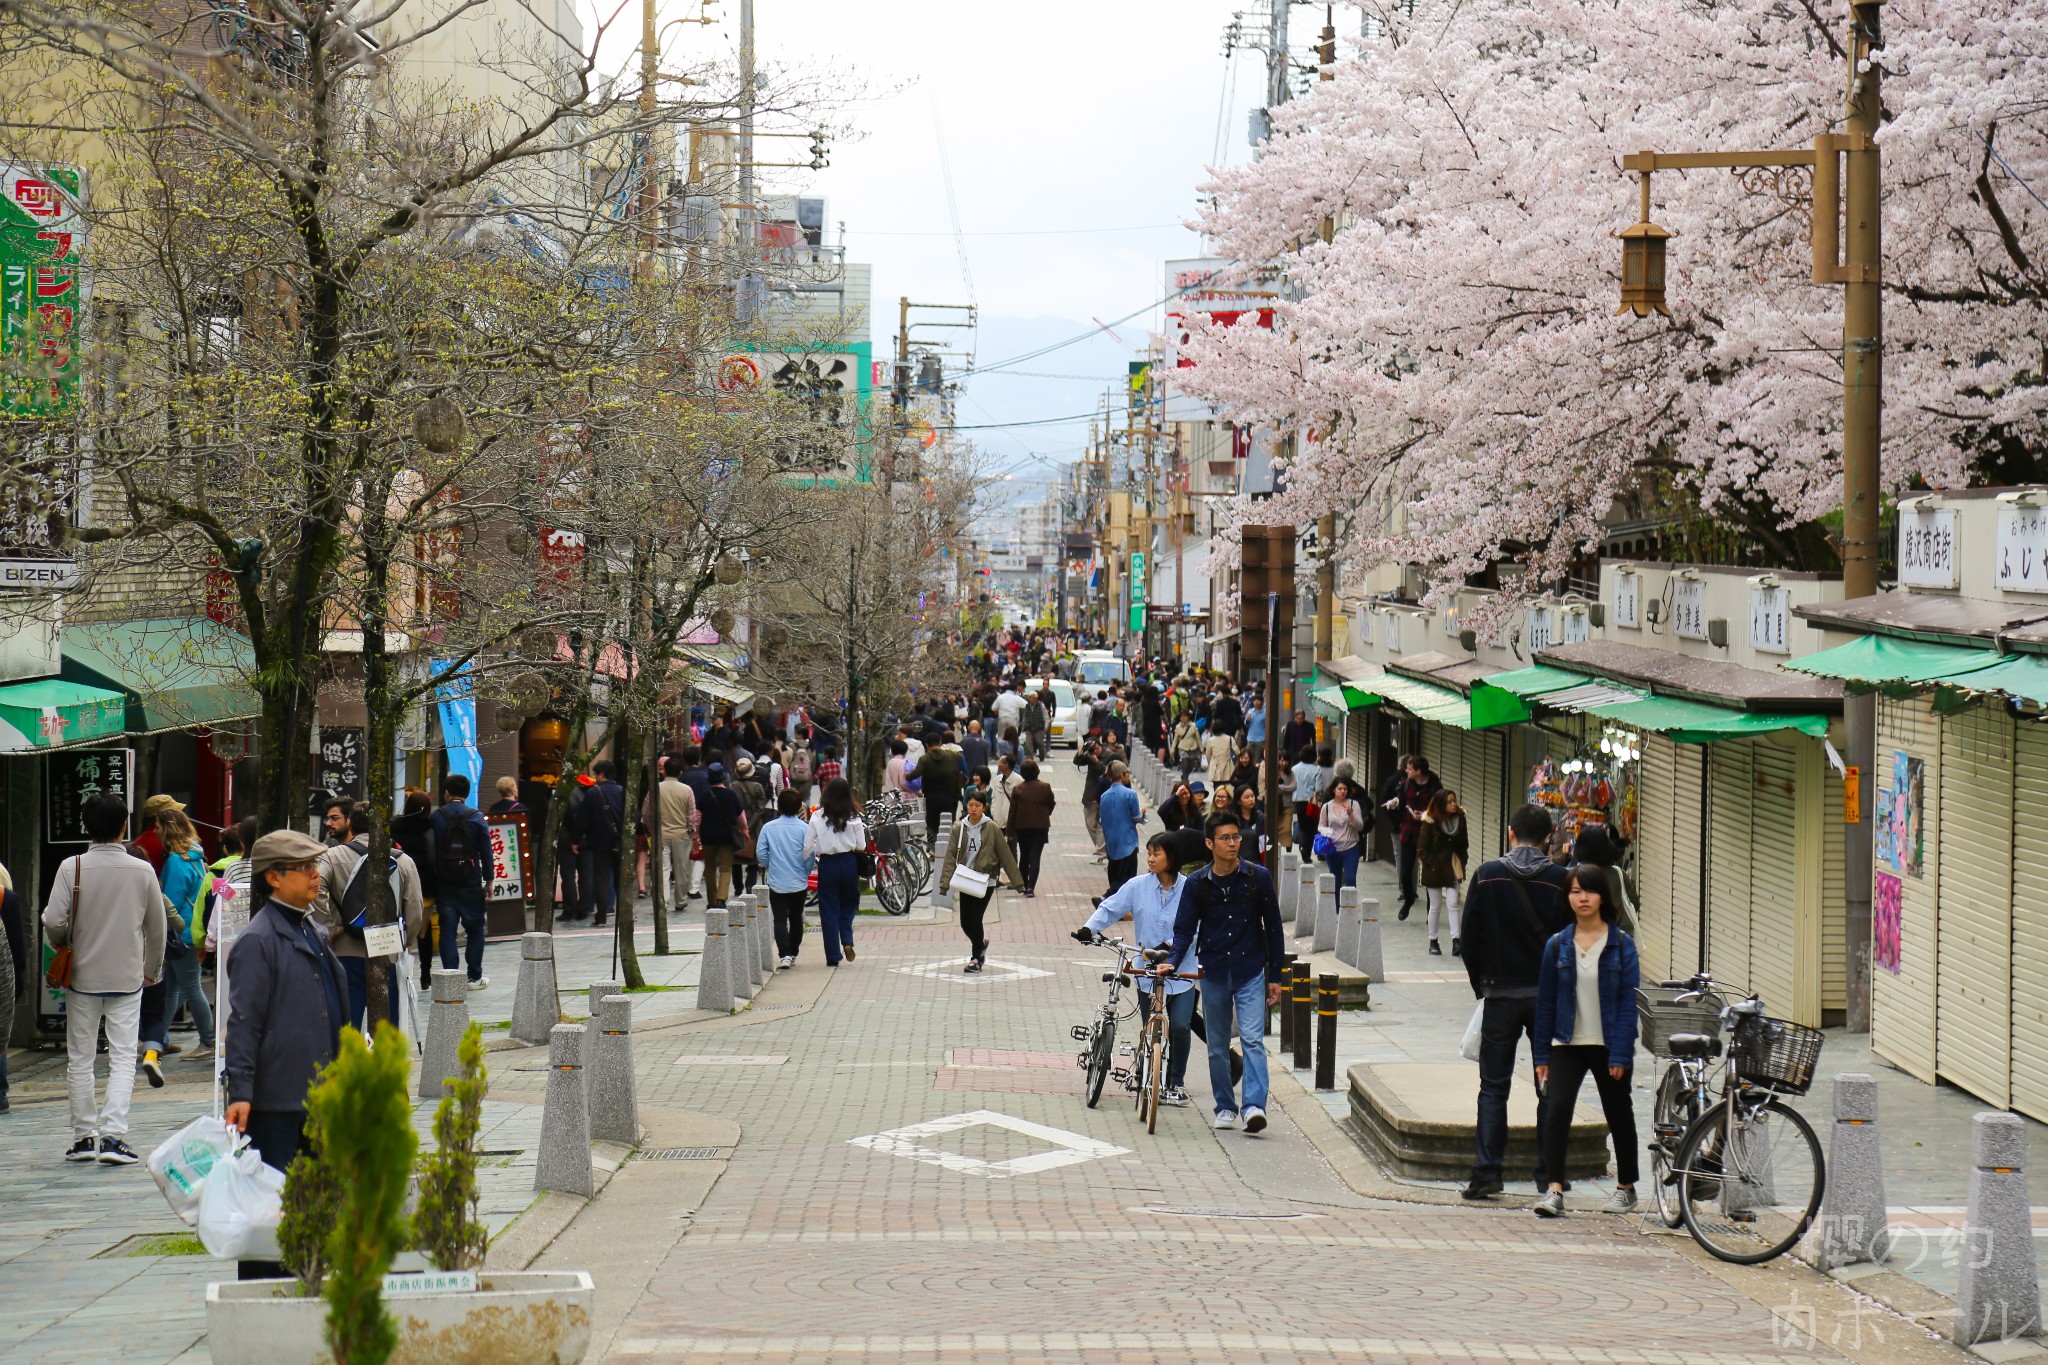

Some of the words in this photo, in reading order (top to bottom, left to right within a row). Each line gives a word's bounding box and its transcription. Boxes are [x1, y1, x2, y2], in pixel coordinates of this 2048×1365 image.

[1905, 524, 1951, 571] 猿沢商店街
[5, 568, 64, 581] BIZEN
[1676, 603, 1701, 635] 多津美
[38, 714, 70, 737] フジカラー
[218, 885, 229, 893] 2F
